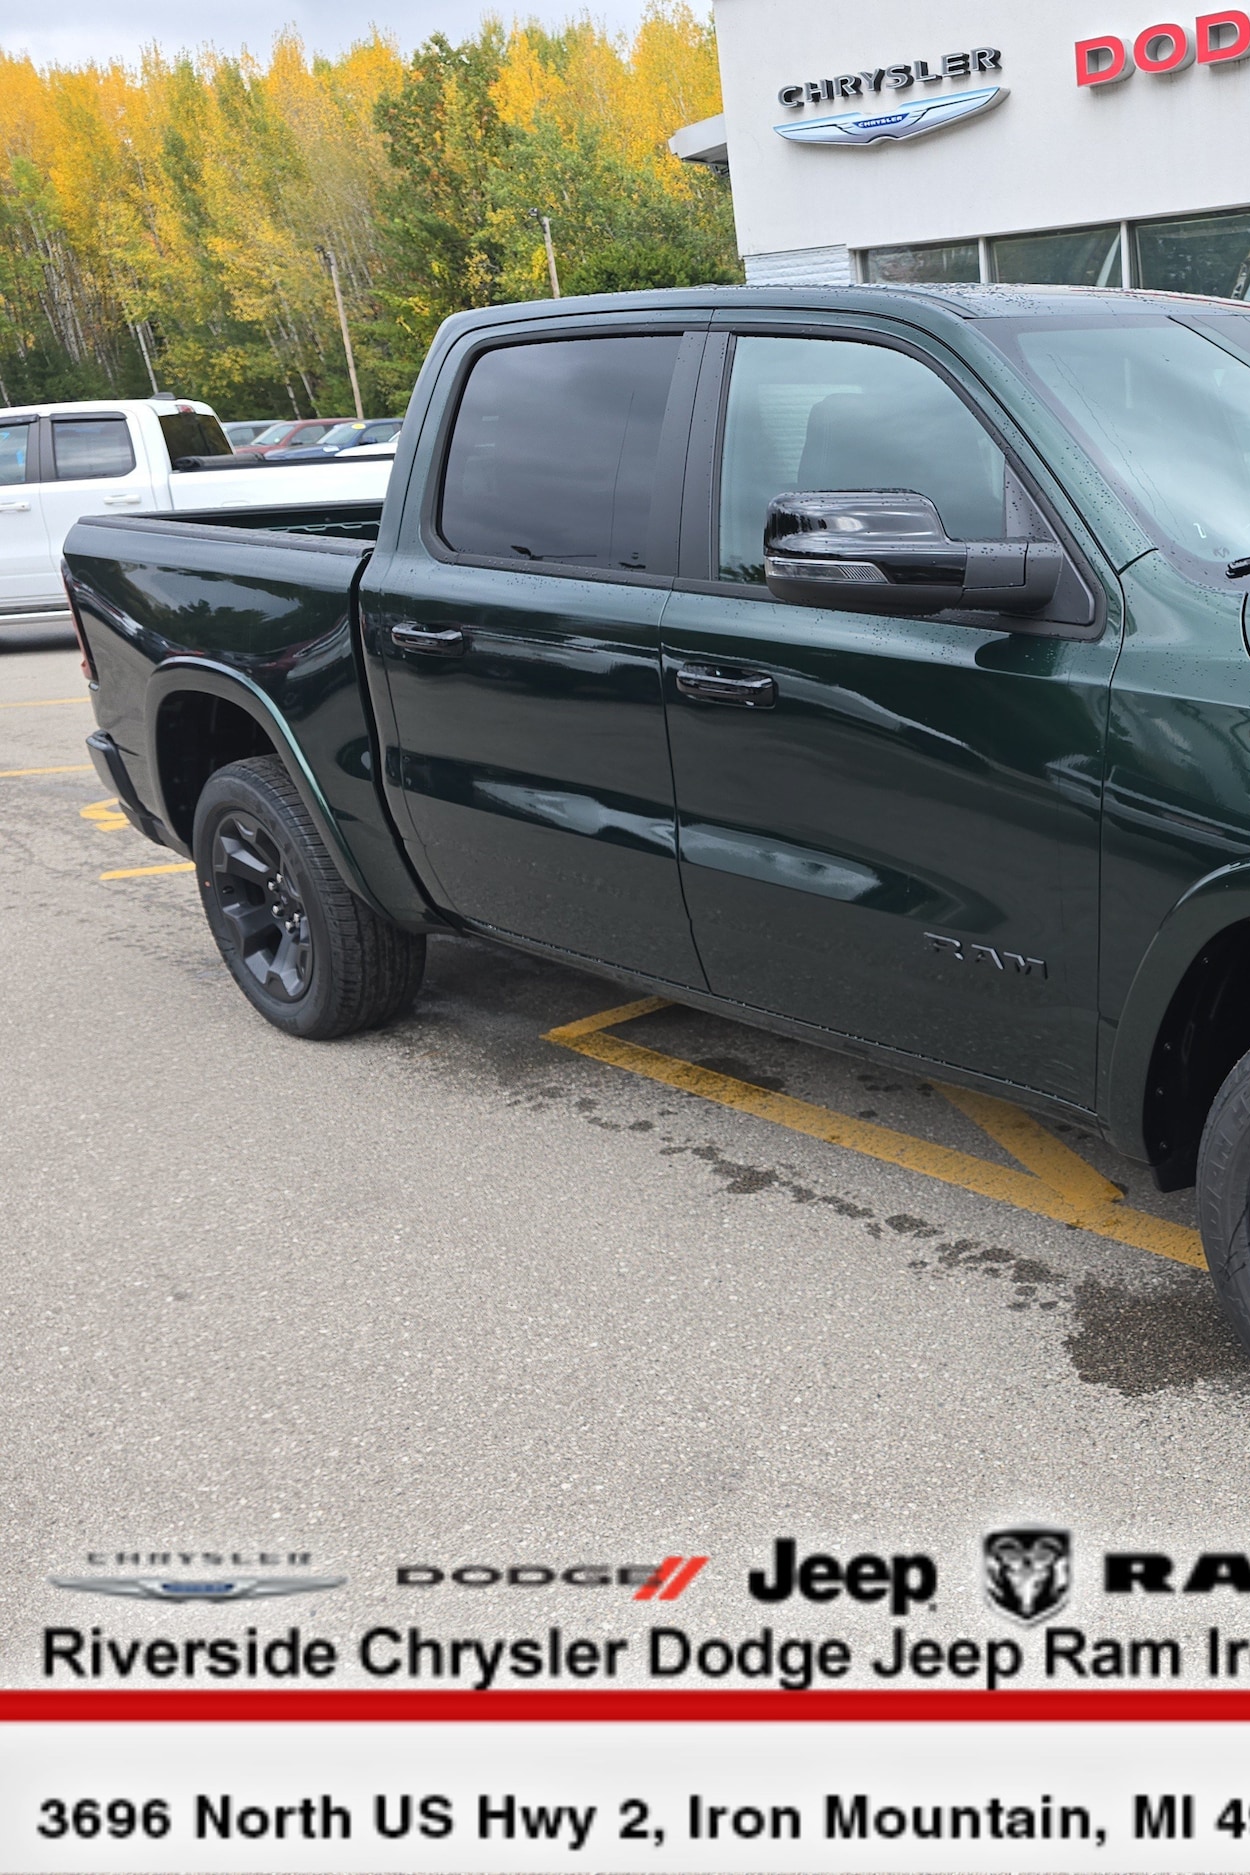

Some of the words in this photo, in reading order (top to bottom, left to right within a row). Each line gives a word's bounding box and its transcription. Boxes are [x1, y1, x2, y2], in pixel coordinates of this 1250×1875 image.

[778, 46, 1002, 109] CHRYSLER
[857, 114, 903, 129] CHRYSLER
[923, 931, 1048, 980] RAM
